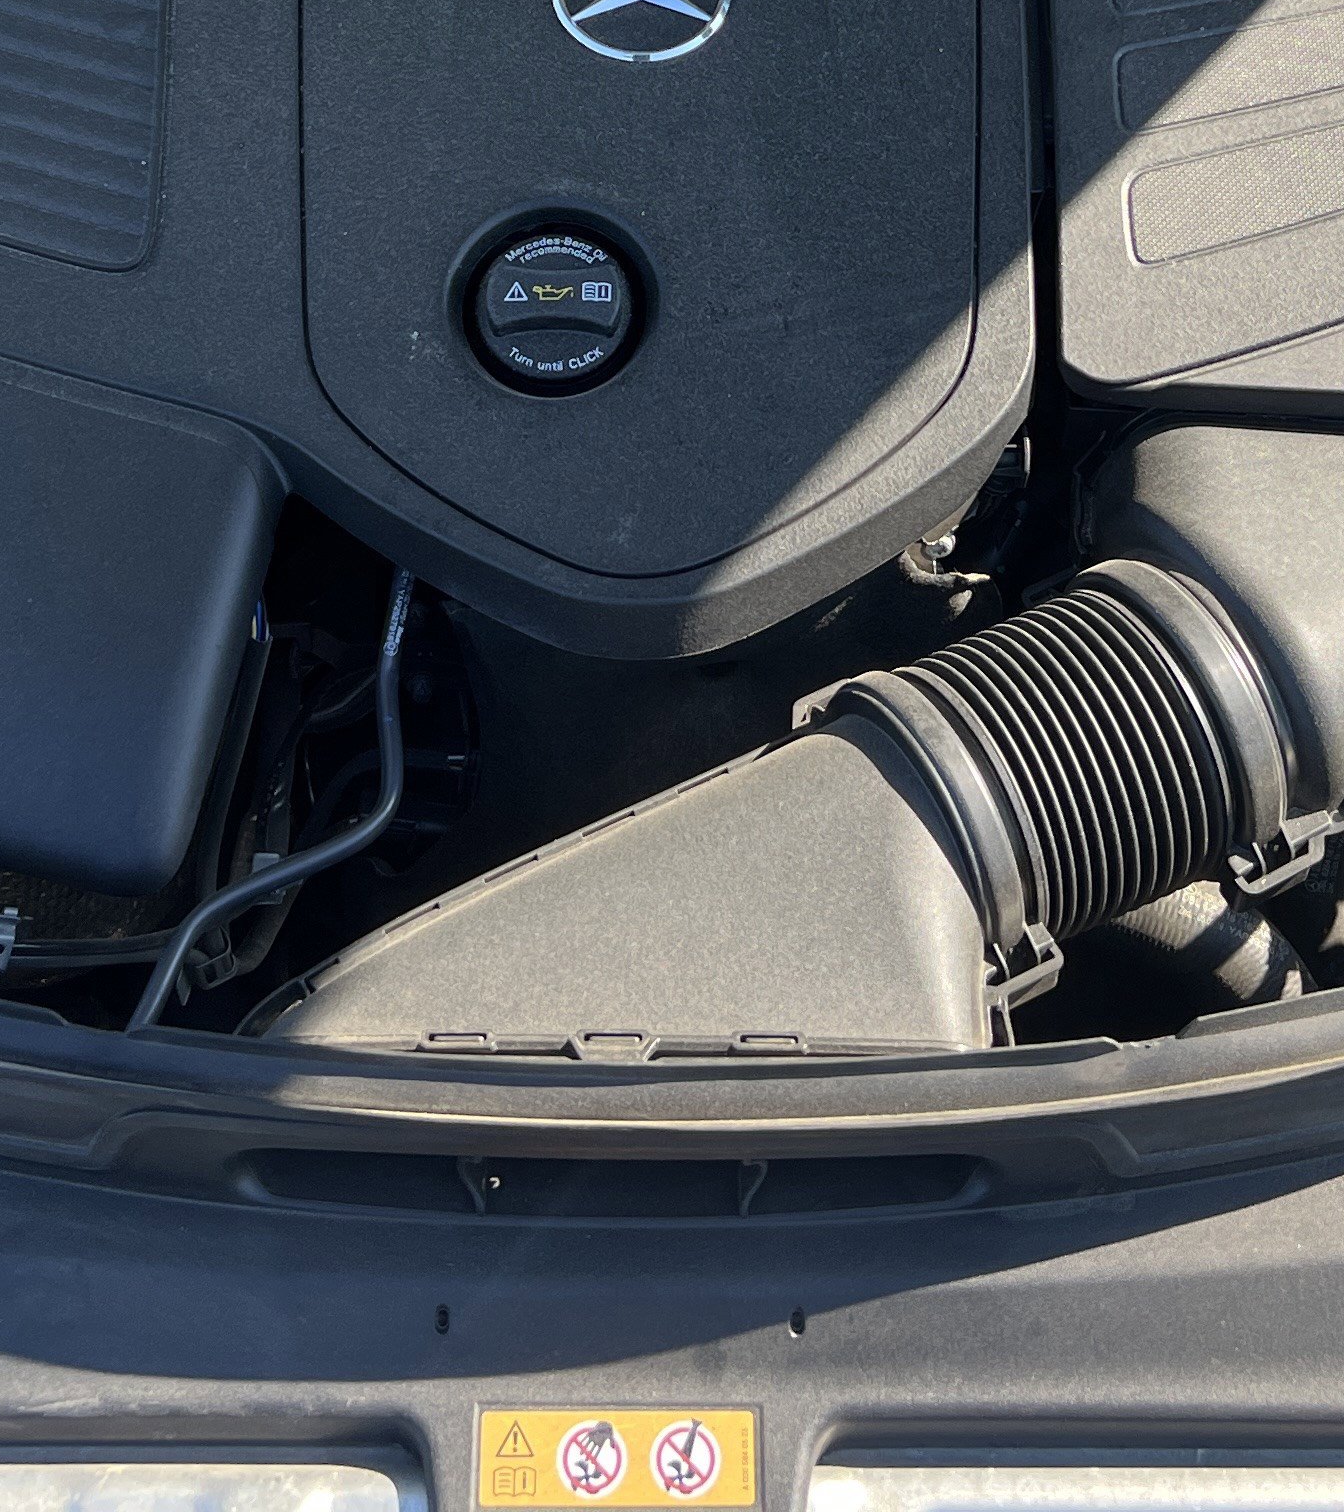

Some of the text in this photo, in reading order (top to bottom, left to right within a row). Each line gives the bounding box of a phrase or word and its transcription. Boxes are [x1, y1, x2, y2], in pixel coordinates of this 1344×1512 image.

[504, 237, 608, 262] Mercedes-Benz Oil
[519, 245, 596, 264] recommended
[508, 346, 604, 372] Turn until CLICK
